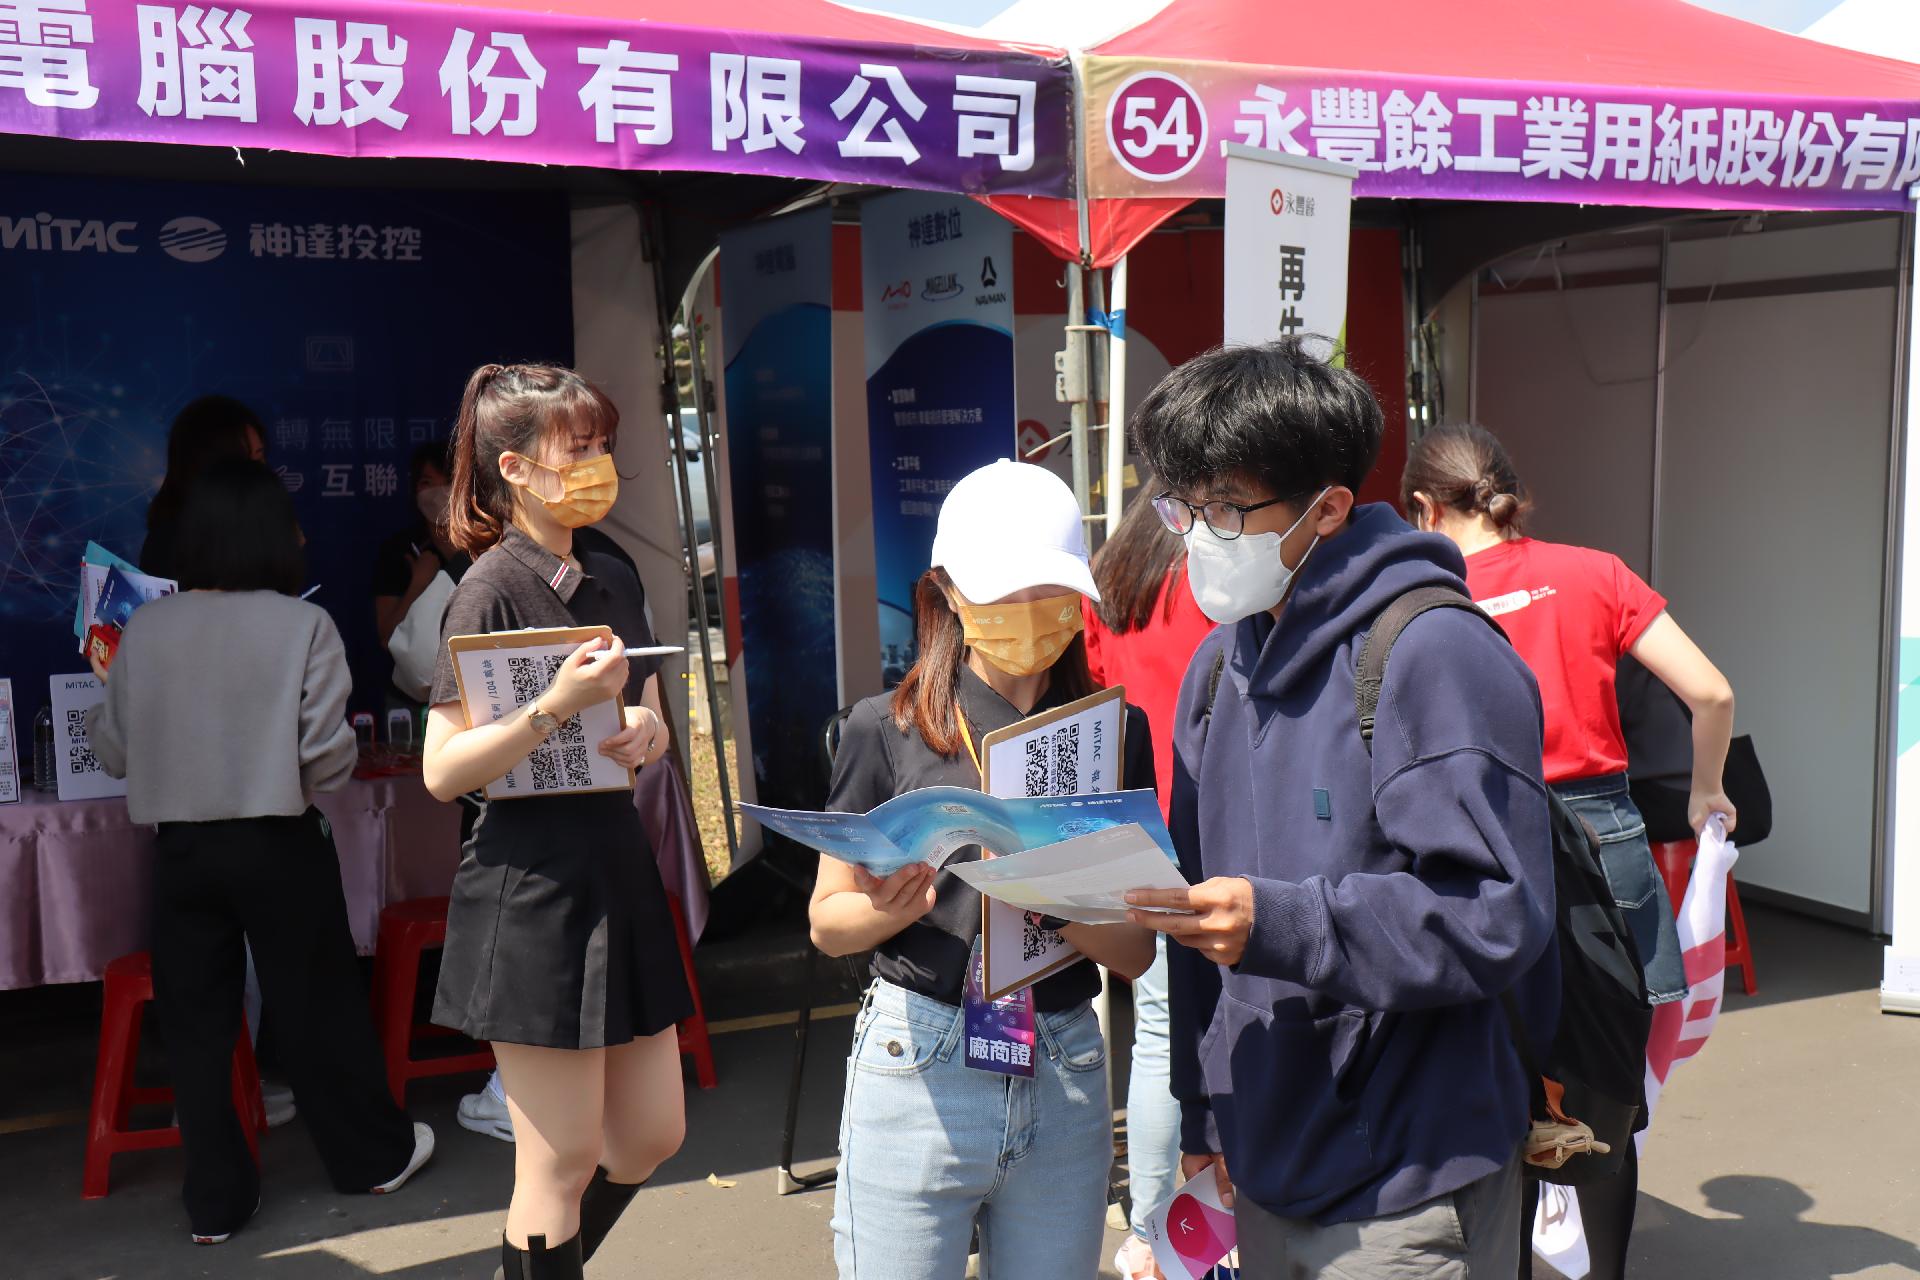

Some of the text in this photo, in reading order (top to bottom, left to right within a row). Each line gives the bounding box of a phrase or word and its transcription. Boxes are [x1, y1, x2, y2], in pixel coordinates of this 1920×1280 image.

[0, 3, 1037, 172] 電腦股份有限公司
[1121, 95, 1196, 160] 54
[1284, 191, 1316, 217] 永豐餘
[0, 211, 139, 254] MiTAC
[248, 222, 423, 262] 神達投控
[974, 292, 1007, 307] NAVMAN
[274, 416, 437, 451] 轉無限可
[64, 680, 95, 690] MiTAC
[1093, 719, 1103, 762] MiTAC
[968, 1036, 1032, 1068] 廠商證
